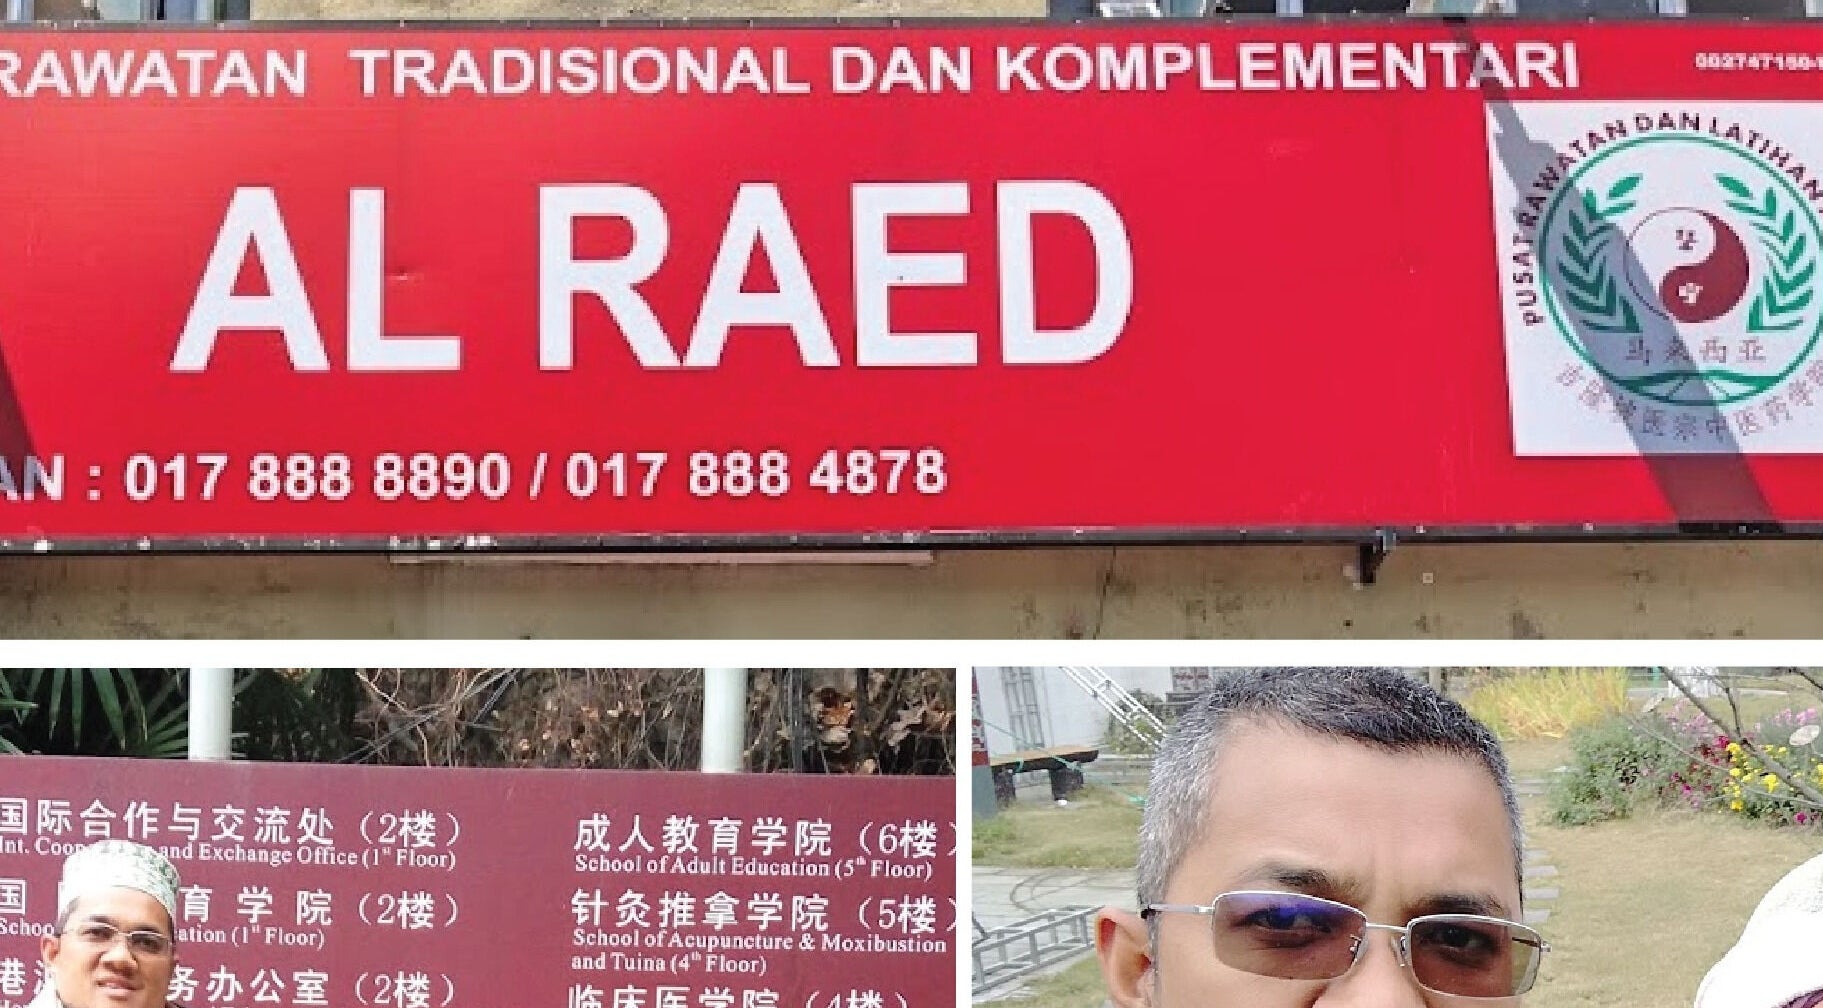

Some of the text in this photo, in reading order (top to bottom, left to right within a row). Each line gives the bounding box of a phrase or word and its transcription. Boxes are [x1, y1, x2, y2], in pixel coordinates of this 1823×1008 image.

[348, 46, 811, 97] TRADISIONAL
[832, 46, 971, 94] DAN
[996, 42, 1579, 92] KOMPLEMENTARI
[1634, 112, 1699, 131] DAN
[1518, 120, 1627, 227] RAWATAN
[169, 179, 1134, 371] AL RAED
[1513, 233, 1545, 327] PUSAT
[126, 454, 228, 501] 017
[248, 453, 352, 501] 888
[373, 452, 511, 501] 8890
[529, 452, 548, 498] /
[565, 452, 668, 498] 017
[688, 449, 789, 498] 888
[809, 449, 946, 495] 4878
[199, 843, 293, 868] Exchange
[297, 845, 358, 865] Office
[396, 848, 457, 870] Floor)
[575, 855, 641, 873] School
[647, 856, 668, 874] of
[670, 856, 727, 876] Adult
[731, 858, 829, 877] Education
[871, 860, 933, 882] Floor)
[0, 917, 55, 937] Schoo
[265, 927, 325, 950] Floor)
[573, 929, 947, 954] School of Acupuncture & Moxibustion
[571, 952, 606, 970] and
[611, 953, 665, 971] Tuina
[706, 955, 767, 976] Floor)
